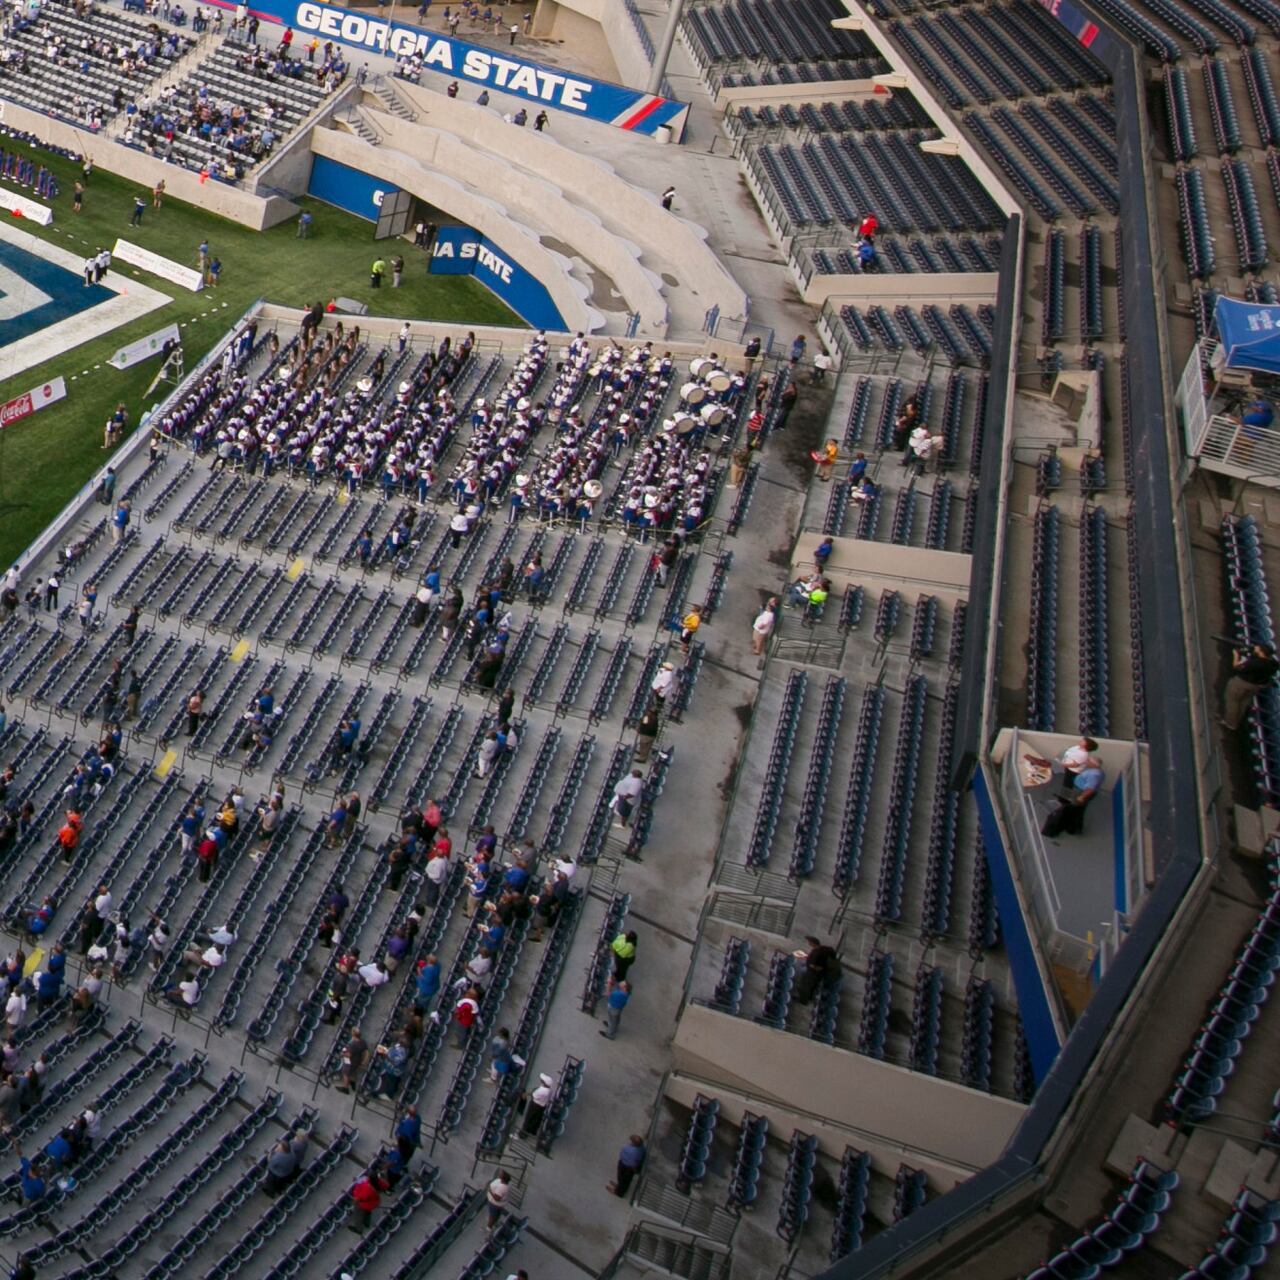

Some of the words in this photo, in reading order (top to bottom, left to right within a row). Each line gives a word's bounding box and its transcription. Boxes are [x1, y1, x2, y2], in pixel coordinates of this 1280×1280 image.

[296, 1, 454, 71] GEORGIA
[462, 48, 594, 113] STATE
[459, 241, 514, 284] STATE
[0, 393, 32, 422] Coca-Cola
